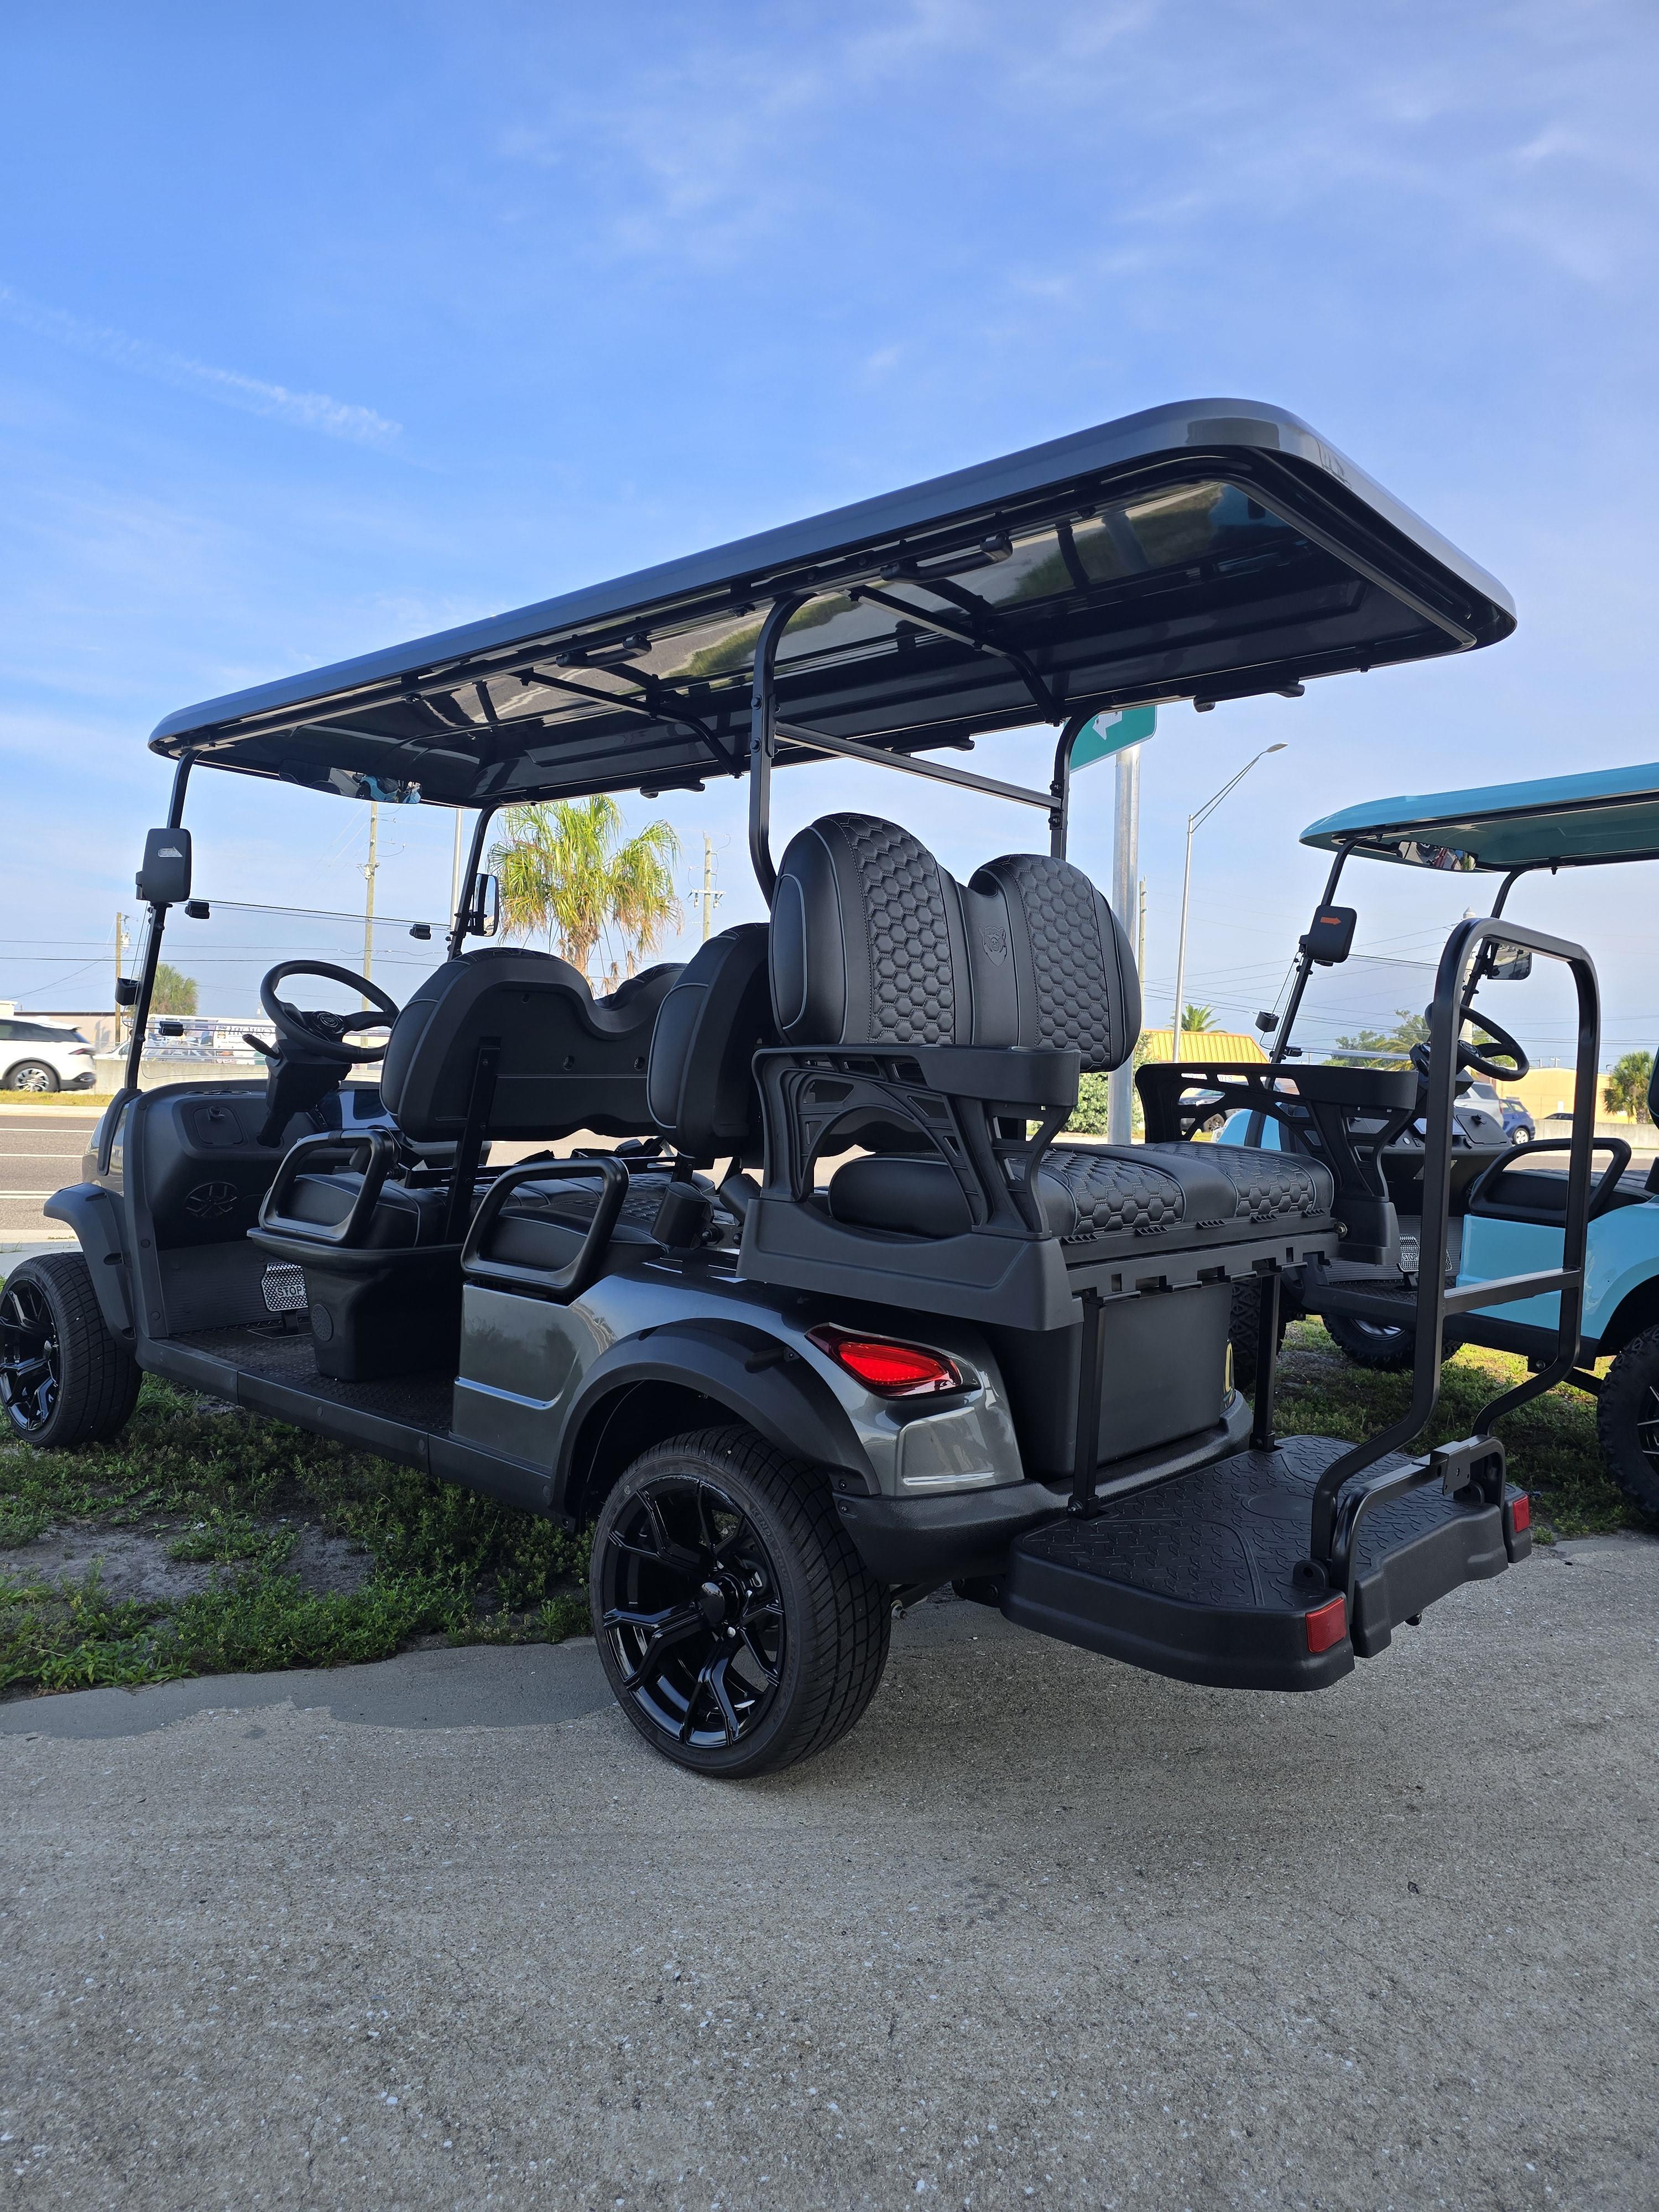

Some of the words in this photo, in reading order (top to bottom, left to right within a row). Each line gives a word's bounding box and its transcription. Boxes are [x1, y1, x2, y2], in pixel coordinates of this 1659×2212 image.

[277, 1286, 302, 1296] STOP
[751, 1507, 775, 1543] KENDA
[627, 1700, 653, 1735] RADIAL
